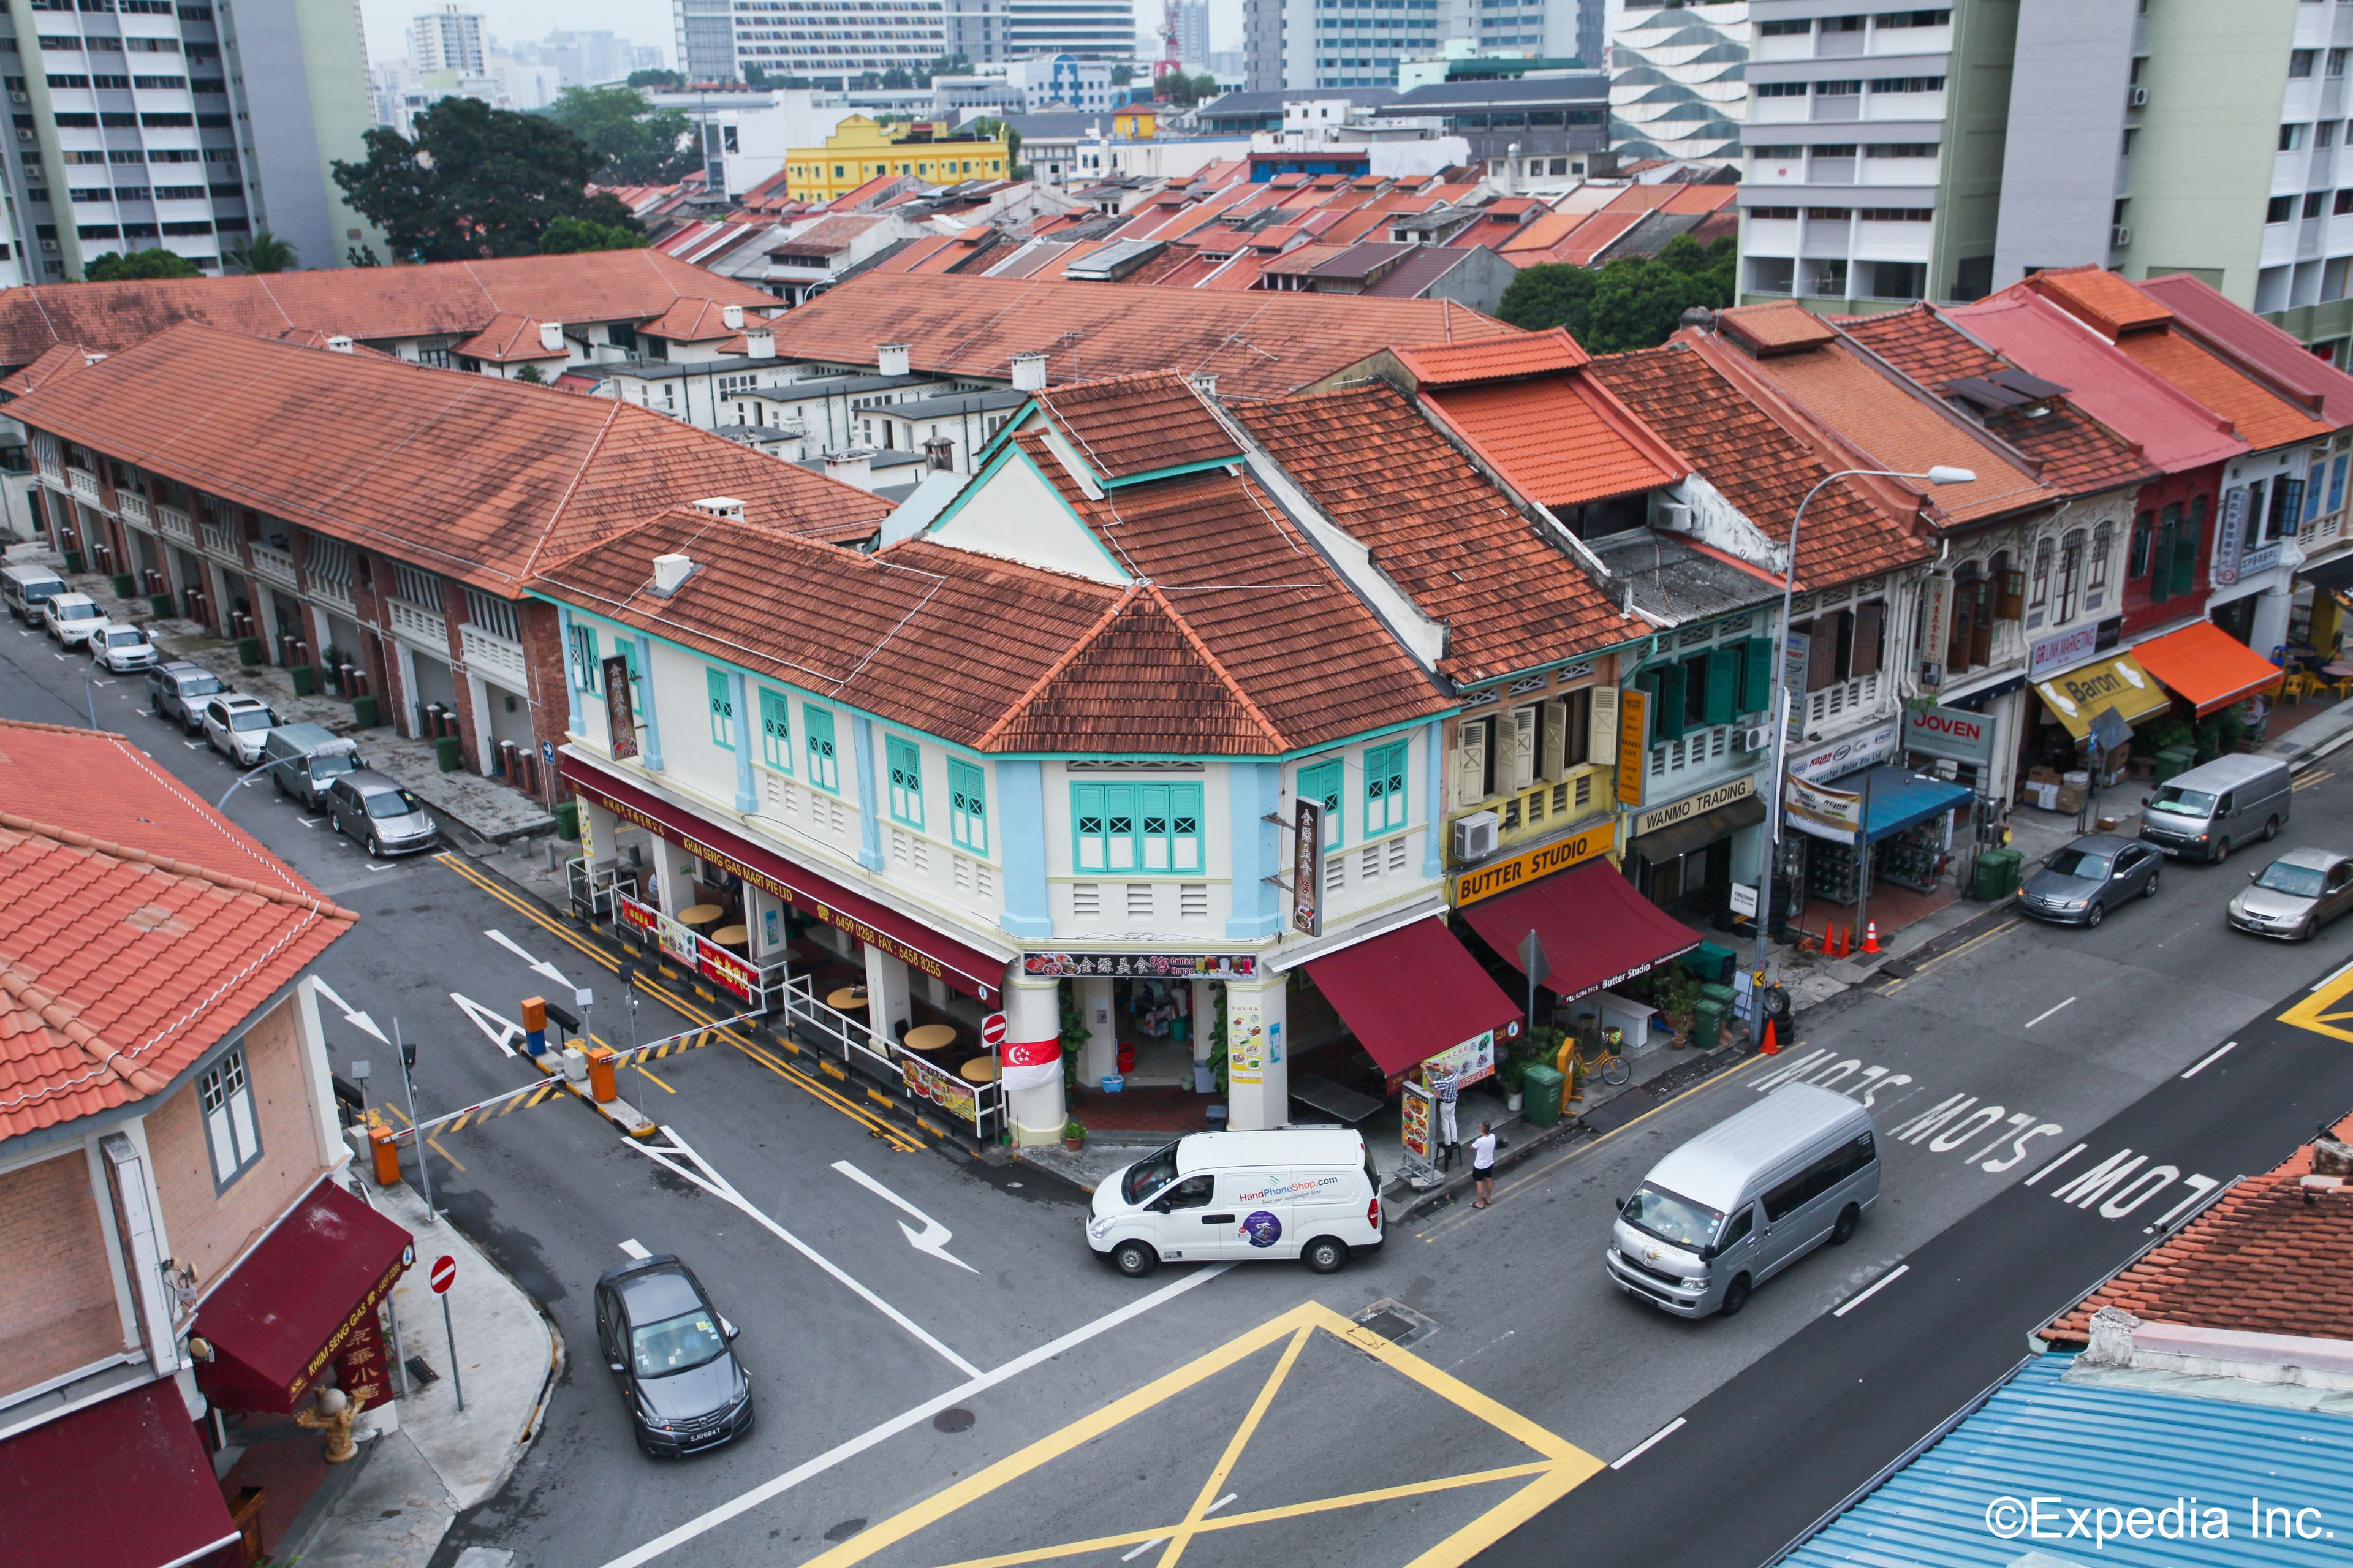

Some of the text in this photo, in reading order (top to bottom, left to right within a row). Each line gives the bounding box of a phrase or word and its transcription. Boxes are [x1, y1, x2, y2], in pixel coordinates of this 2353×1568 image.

[2036, 645, 2046, 665] GR
[2046, 639, 2060, 661] LINK
[2060, 627, 2094, 656] MARKETING
[2064, 673, 2121, 703] Baron
[1913, 714, 1980, 740] JOVEN
[1621, 738, 1641, 749] BAKERY
[1624, 749, 1637, 757] CAFE
[1623, 764, 1637, 773] COFFEE
[1792, 762, 1808, 774] SHOEI
[1809, 751, 1833, 768] NOLAN
[1841, 761, 1858, 772] Motor
[1860, 756, 1870, 766] Pte
[1873, 749, 1882, 760] Ltd
[1646, 781, 1746, 830] WANMO TRADING
[1300, 808, 1314, 877] 金源美食
[683, 837, 793, 902] KHIM SENG GAS MART PTE LTD
[1461, 837, 1588, 900] BUTTER STUDIO
[836, 914, 941, 978] 6459 0288 FAX 6458 8255
[1080, 956, 1152, 975] 金源美食
[1149, 955, 1172, 974] KG
[1171, 957, 1194, 966] Coffee
[1171, 966, 1194, 975] House
[1588, 984, 1599, 993] 7115
[1602, 974, 1626, 990] Butter
[1627, 963, 1651, 979] Studio
[1885, 1092, 2063, 1173] SLOW
[1239, 1176, 1338, 1202] HandPhoneShop.com
[291, 1377, 303, 1393] KSG
[308, 1347, 329, 1376] KHIM
[328, 1323, 349, 1352] SENG
[350, 1302, 366, 1327] GAS
[378, 1274, 390, 1293] 6459
